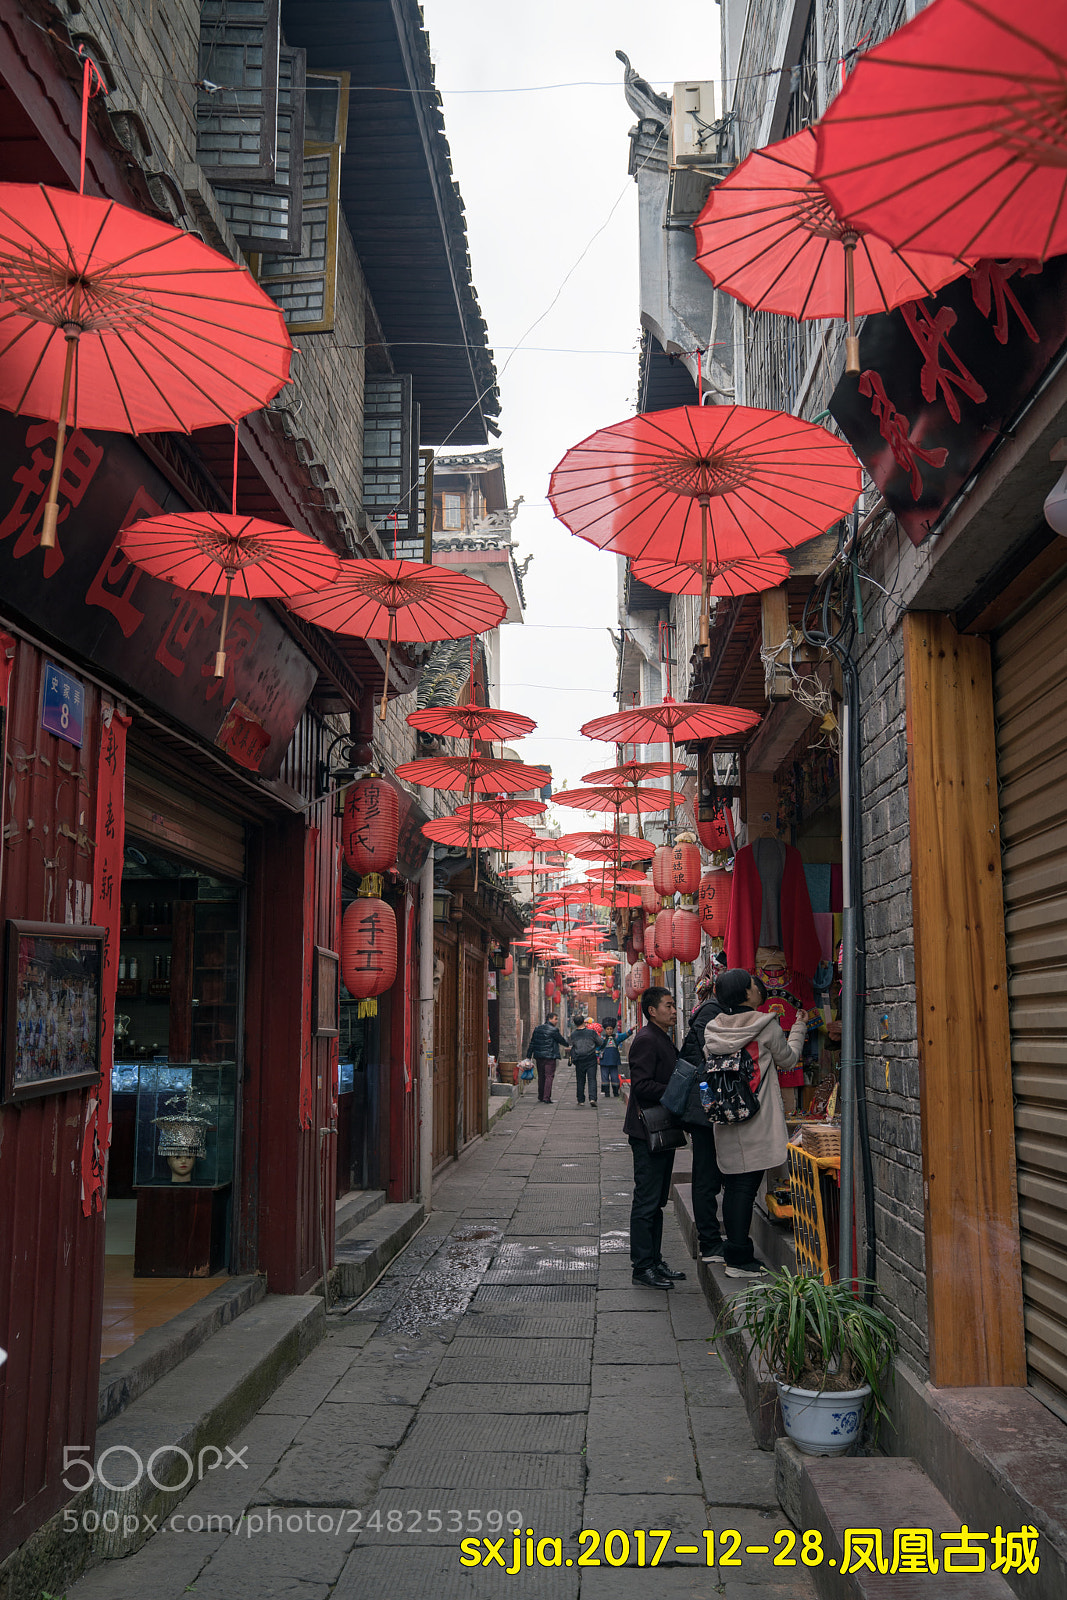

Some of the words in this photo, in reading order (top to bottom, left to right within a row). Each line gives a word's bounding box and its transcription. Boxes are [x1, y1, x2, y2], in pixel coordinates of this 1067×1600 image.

[60, 703, 69, 729] 8
[673, 849, 687, 884] 苗姑娘
[700, 884, 716, 923] 的店
[354, 912, 384, 972] 手工
